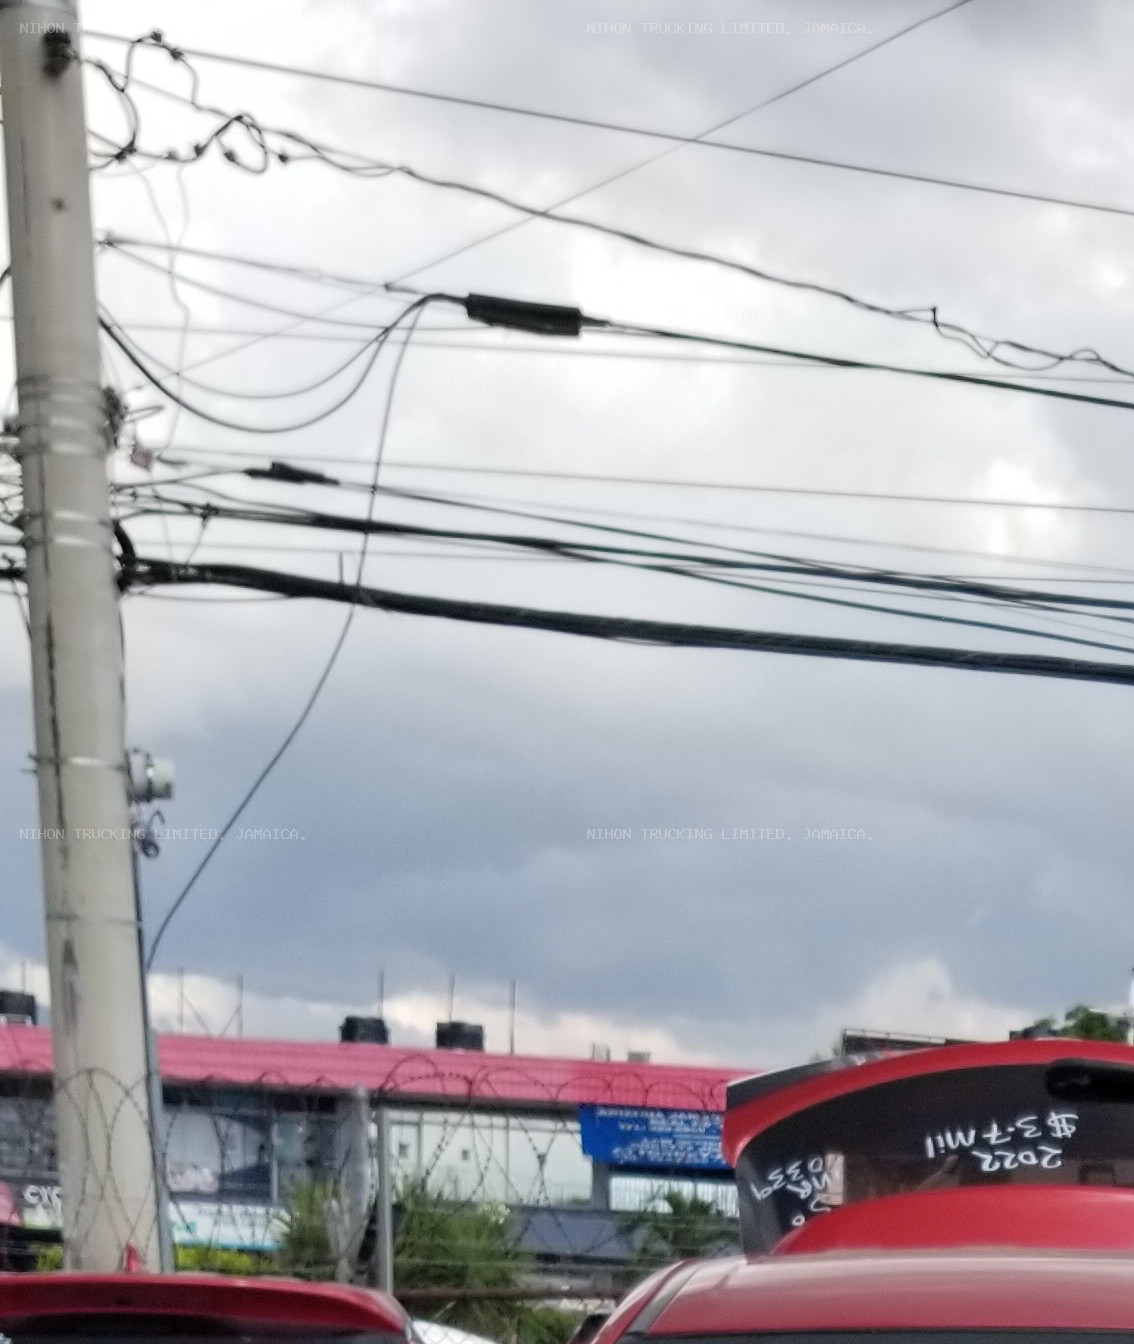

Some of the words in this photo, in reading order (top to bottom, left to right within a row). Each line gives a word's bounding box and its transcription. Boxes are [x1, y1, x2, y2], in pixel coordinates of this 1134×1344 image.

[982, 1111, 1079, 1146] $3.7
[970, 1145, 1063, 1172] 2022
[750, 1156, 824, 1201] 0339
[785, 1172, 833, 1201] MR
